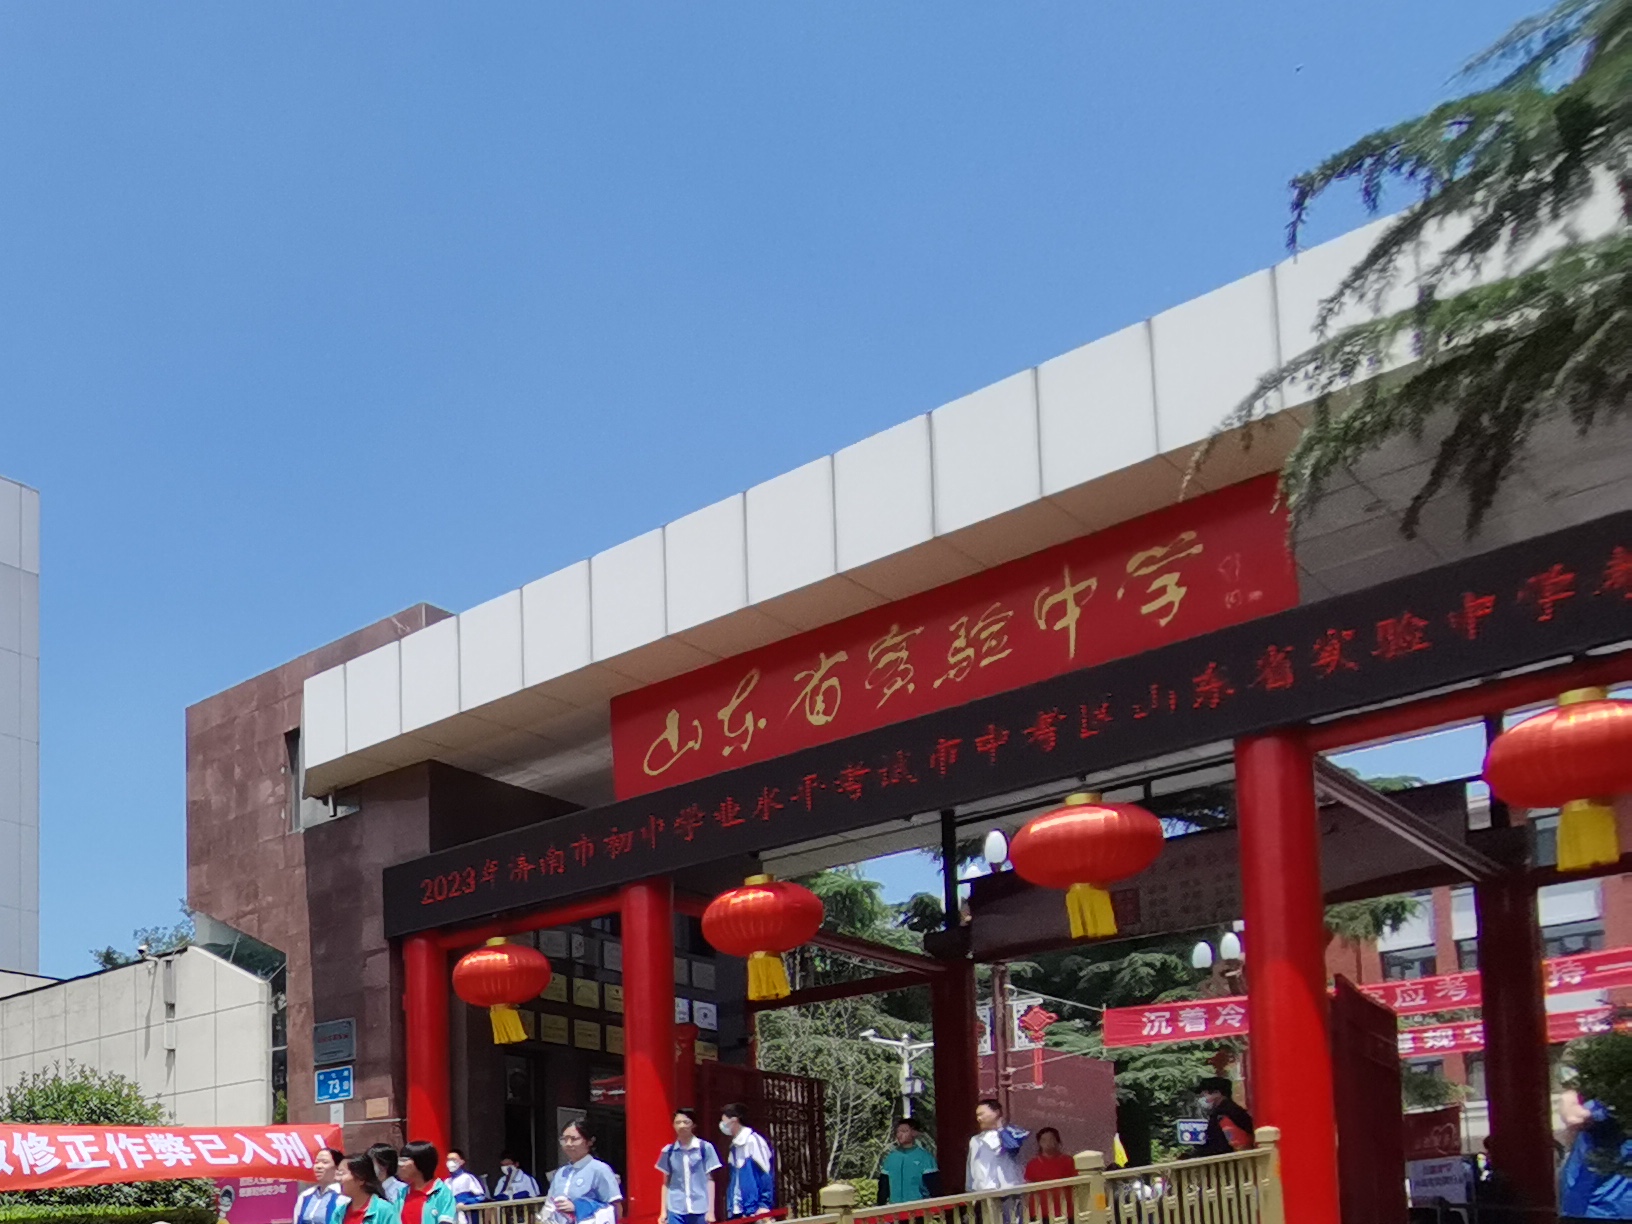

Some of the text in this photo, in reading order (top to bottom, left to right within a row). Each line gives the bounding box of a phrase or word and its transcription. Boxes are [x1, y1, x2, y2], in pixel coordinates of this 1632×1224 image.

[644, 530, 1204, 776] 山东省实验中学
[1142, 1003, 1246, 1036] 沉着冷
